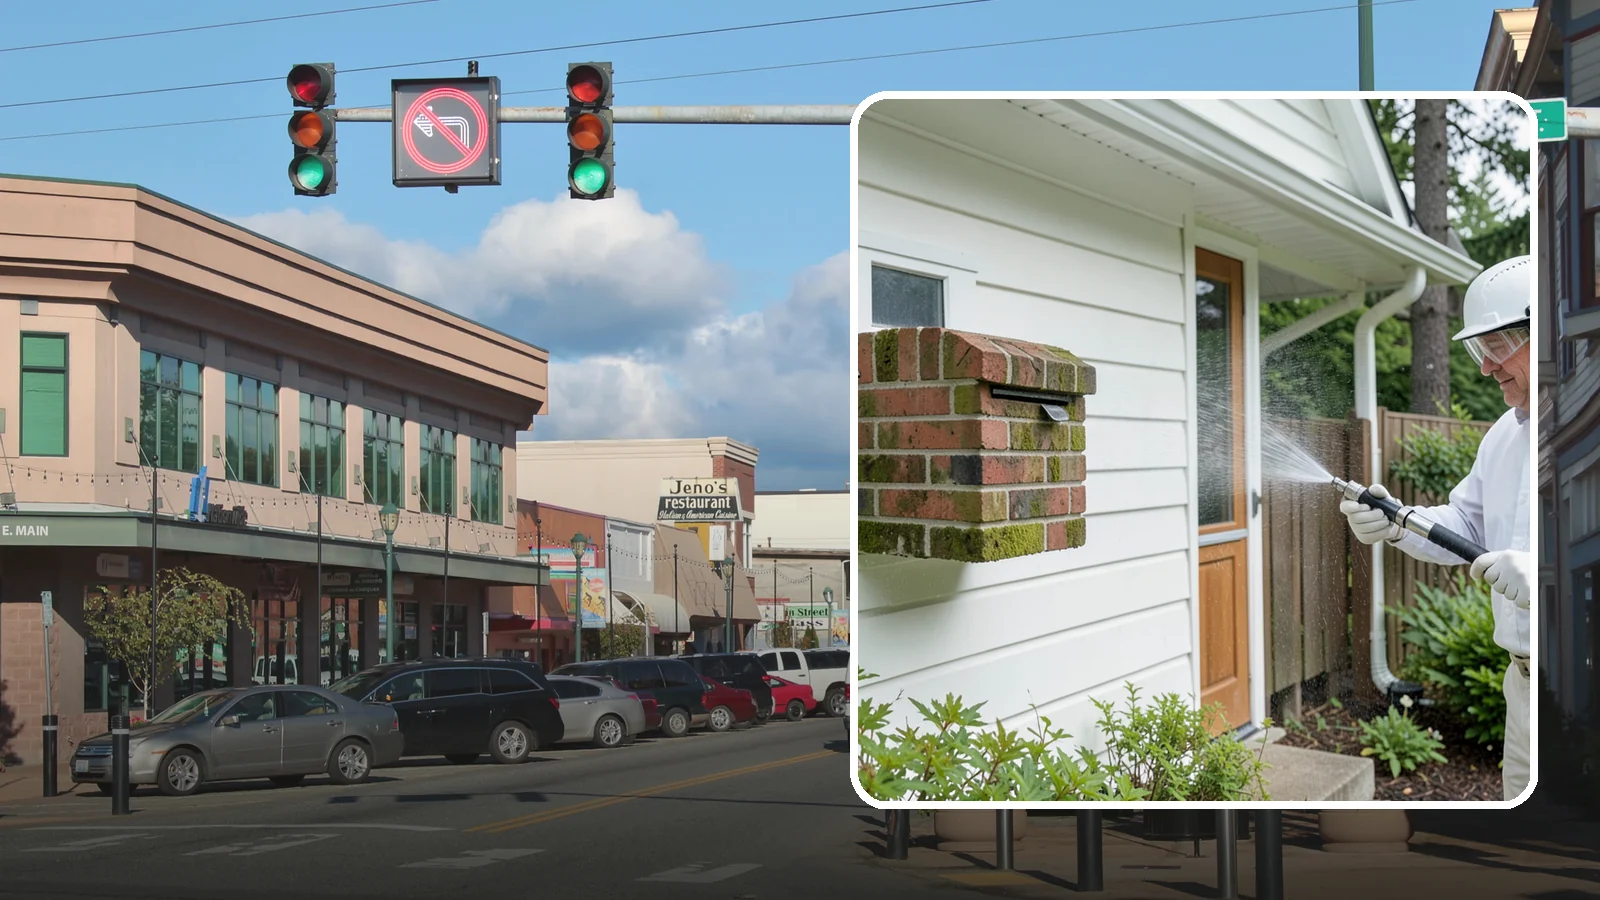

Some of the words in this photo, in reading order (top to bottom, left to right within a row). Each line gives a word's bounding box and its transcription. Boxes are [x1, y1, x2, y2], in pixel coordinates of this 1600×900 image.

[670, 480, 727, 494] Jeno's
[665, 496, 731, 508] restaurant
[658, 510, 681, 519] Italian
[686, 509, 715, 519] American
[715, 509, 737, 519] Cuisine
[2, 525, 13, 536] E.
[15, 525, 49, 536] MAIN
[797, 607, 828, 617] Street
